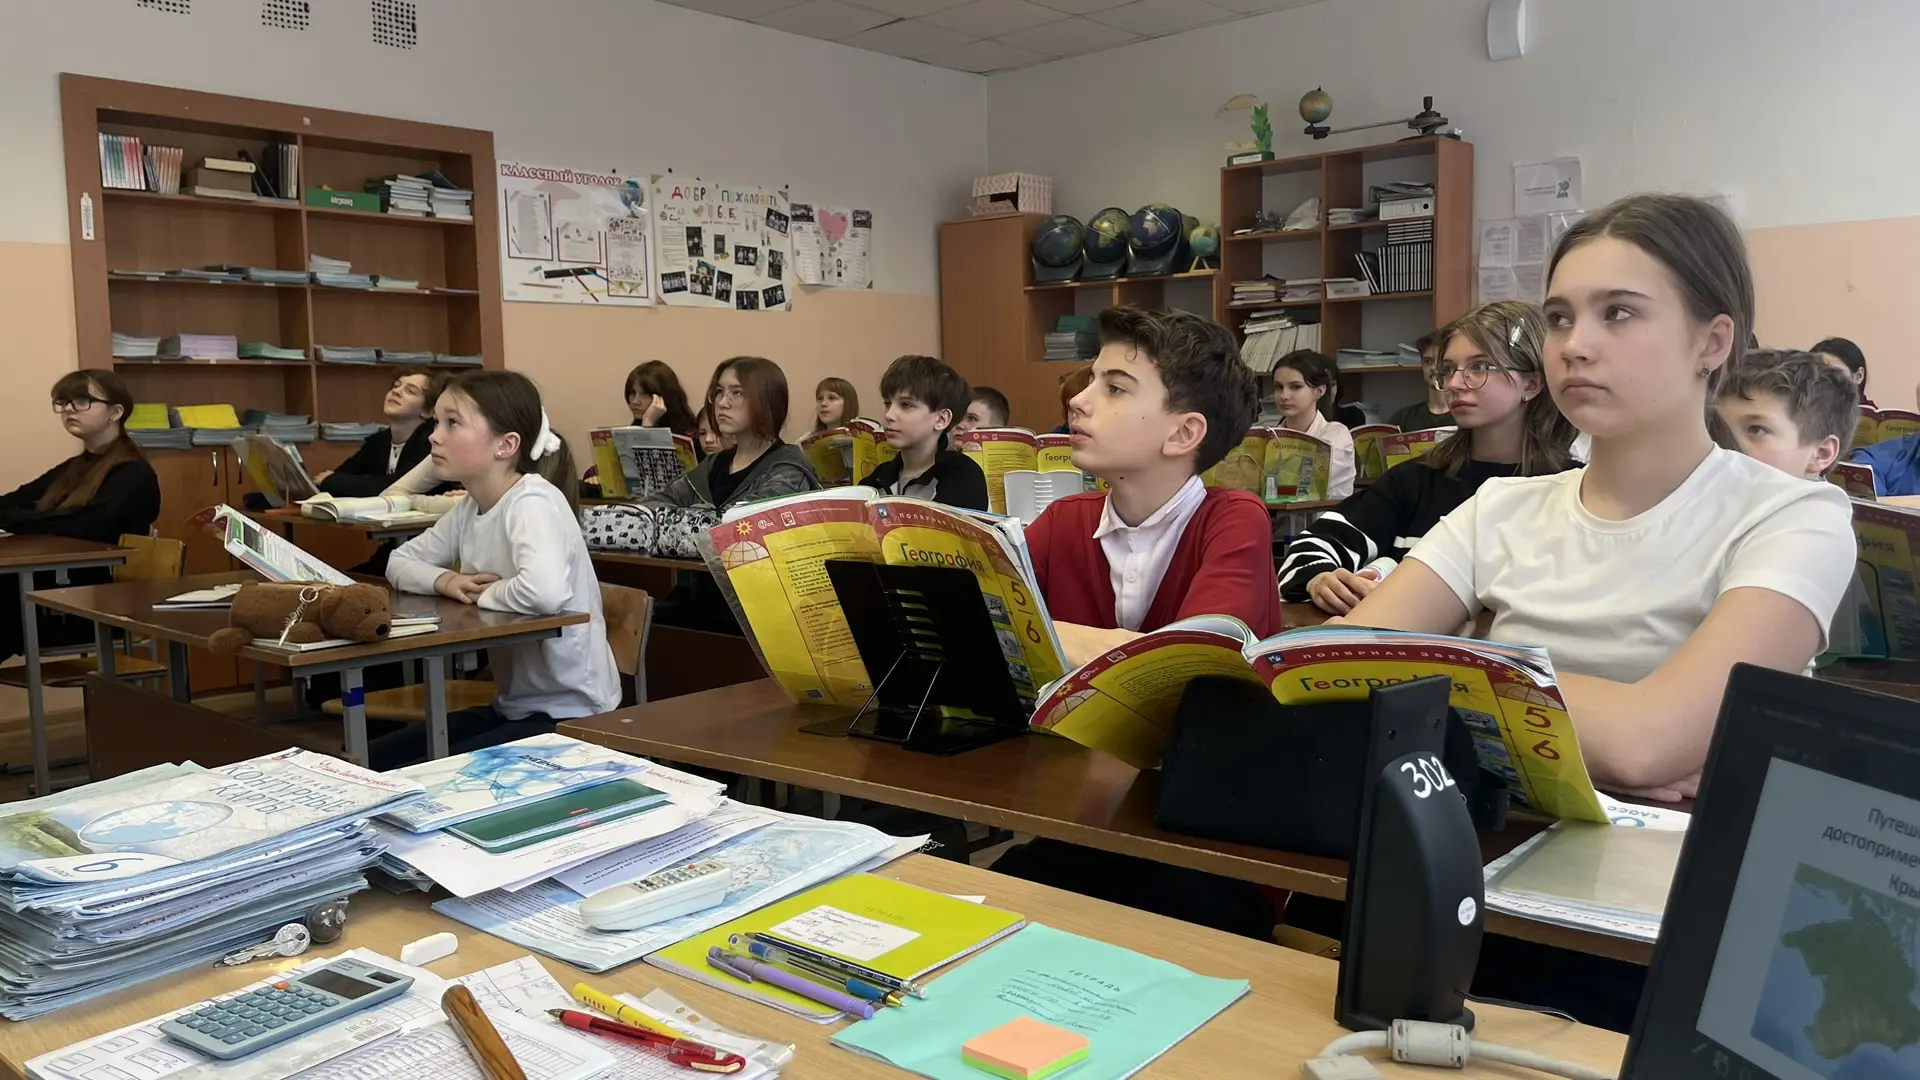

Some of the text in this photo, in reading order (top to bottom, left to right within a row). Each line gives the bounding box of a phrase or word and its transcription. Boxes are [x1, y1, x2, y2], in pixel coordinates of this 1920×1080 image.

[501, 164, 622, 188] КЛАССНЫЙ УГОЛОК
[900, 542, 985, 572] География
[1011, 581, 1026, 606] 5
[1026, 619, 1041, 643] 6
[1302, 649, 1501, 669] ПОЛЯРНАЯ ЗВЕЗДА
[1299, 674, 1469, 694] Геограя
[1524, 706, 1552, 728] 5
[1532, 740, 1560, 762] 6
[220, 764, 357, 813] КОНТУРНЫЕ
[1400, 756, 1456, 798] 302
[209, 783, 296, 815] КАРТЫ
[1868, 807, 1920, 839] Путеш
[1821, 825, 1920, 868] достоприме
[72, 857, 144, 872] 6
[1068, 968, 1121, 992] ТЕТРАДЬ
